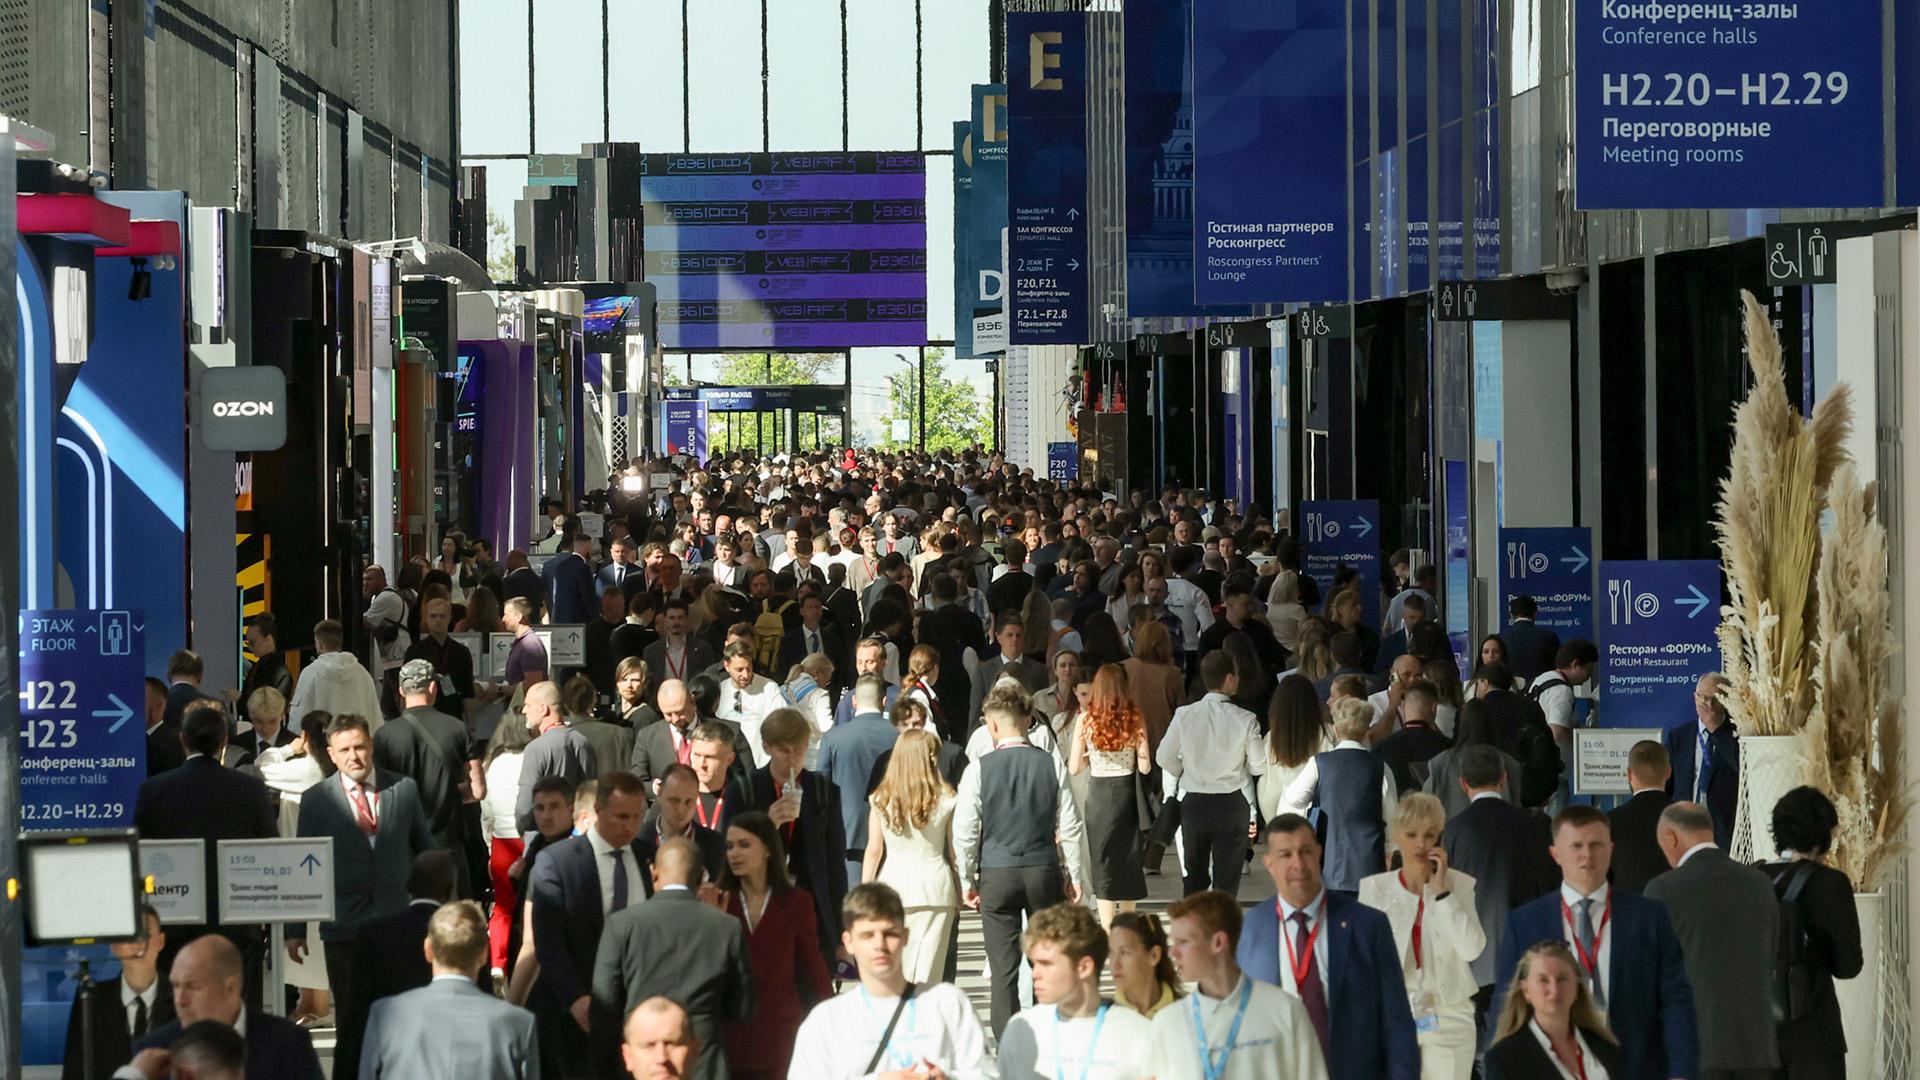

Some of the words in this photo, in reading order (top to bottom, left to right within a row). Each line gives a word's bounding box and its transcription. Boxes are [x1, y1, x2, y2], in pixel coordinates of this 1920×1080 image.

[1602, 0, 1798, 24] Конференц-залы
[1602, 26, 1707, 45] Conference
[1713, 26, 1758, 44] halls
[1602, 117, 1772, 142] Переговорные
[1603, 145, 1679, 167] Meeting
[1686, 147, 1744, 163] rooms
[1207, 221, 1263, 234] Гостиная
[1267, 222, 1334, 235] партнеров
[1207, 236, 1287, 251] Росконгресс
[1208, 255, 1272, 269] Roscongress
[1208, 270, 1247, 283] Lounge
[212, 400, 274, 417] OZON
[1050, 460, 1067, 468] F20
[1050, 470, 1067, 478] F21
[1549, 593, 1592, 602] «ФОРУМ»
[31, 618, 76, 633] ЭТАЖ
[31, 638, 77, 651] FLOOR
[1609, 644, 1658, 656] Ресторан
[1660, 643, 1713, 655] «ФОРУМ»
[1609, 658, 1642, 667] FORUM
[1643, 658, 1689, 667] Restaurant
[1609, 674, 1665, 686] Внутренний
[1666, 675, 1689, 685] двор
[1691, 674, 1698, 683] G
[1609, 685, 1646, 695] Courtyard
[1647, 685, 1654, 693] G
[20, 756, 135, 773] онференц-залы
[20, 773, 77, 785] onference
[80, 773, 108, 785] halls
